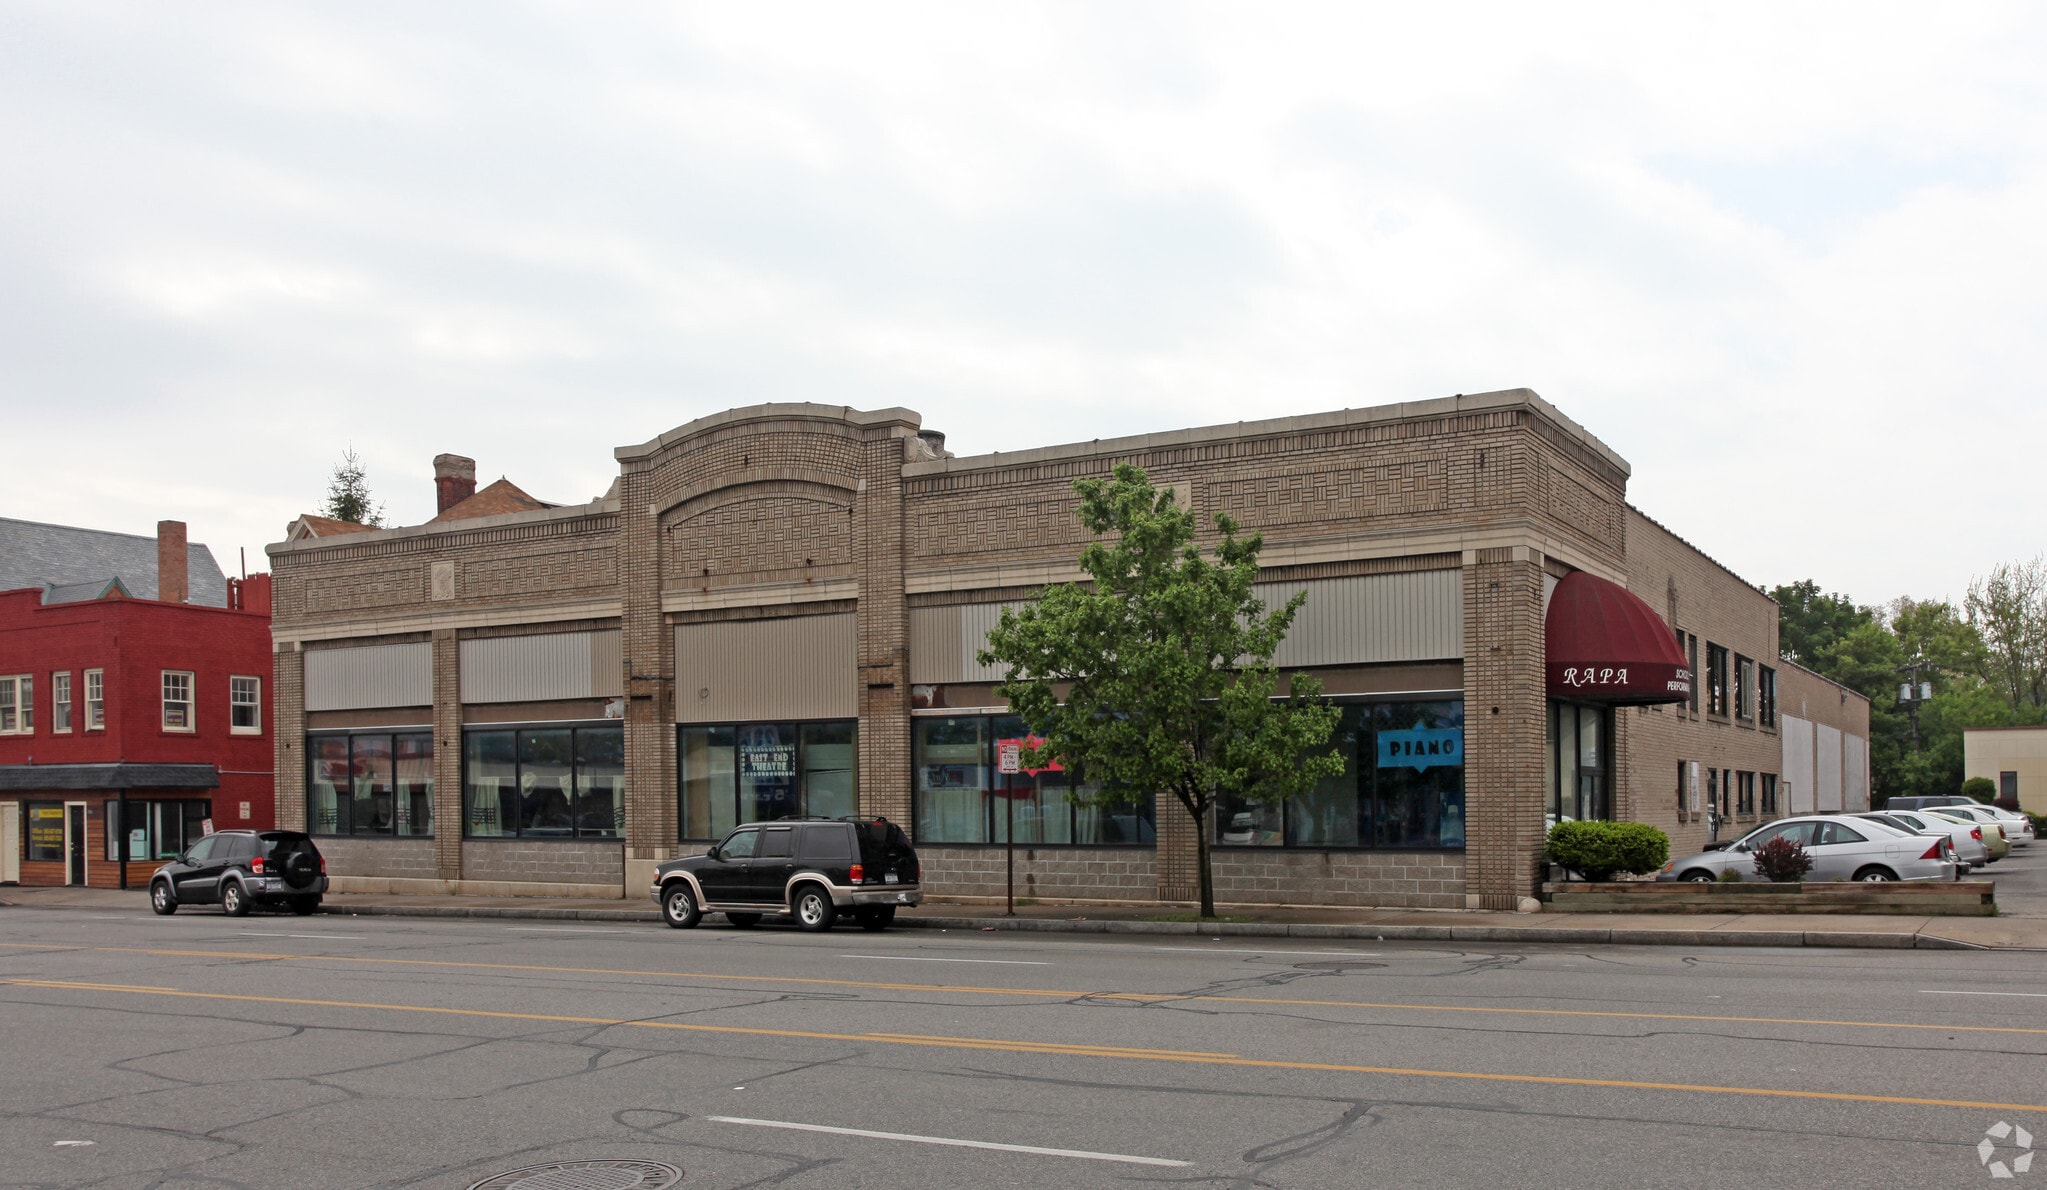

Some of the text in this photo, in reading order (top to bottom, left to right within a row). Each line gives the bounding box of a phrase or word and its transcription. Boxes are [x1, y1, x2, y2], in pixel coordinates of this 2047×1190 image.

[1563, 667, 1629, 688] RAPA
[1389, 739, 1455, 756] PIANO
[749, 752, 789, 762] EAST END
[751, 761, 787, 771] THEATRE
